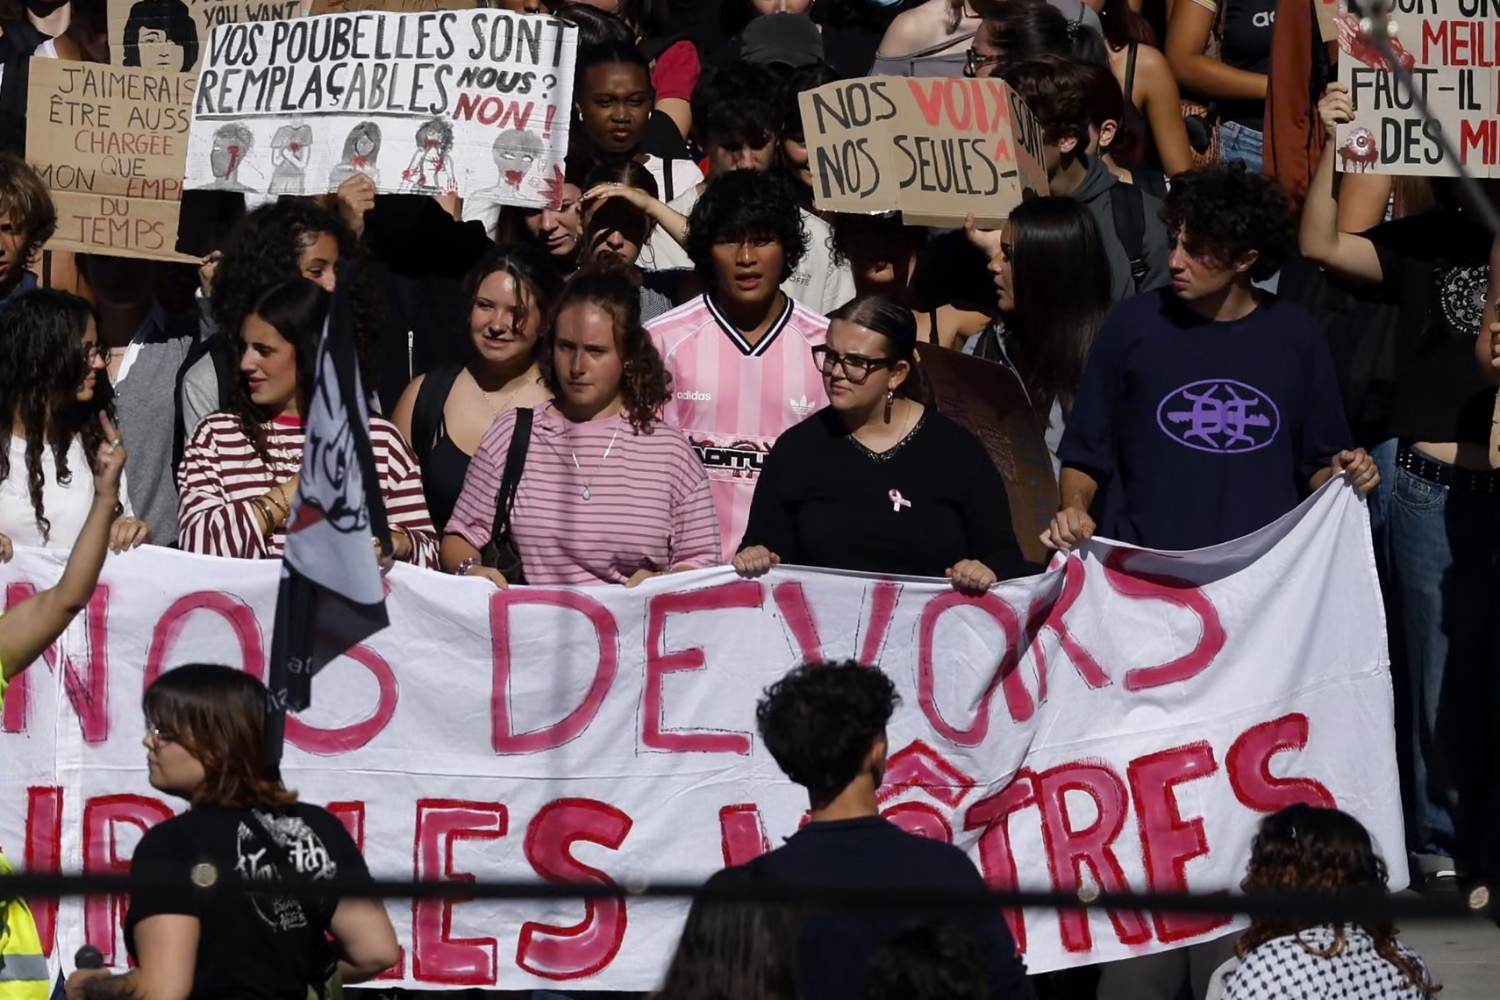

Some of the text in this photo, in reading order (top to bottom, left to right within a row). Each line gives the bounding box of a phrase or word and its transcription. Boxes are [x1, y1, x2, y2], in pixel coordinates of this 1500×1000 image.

[204, 0, 301, 28] YOU WANT
[209, 13, 578, 68] VOS POUBELLES SONT
[58, 66, 198, 106] J'AIMERAIS
[456, 65, 537, 95] NOUS
[49, 94, 111, 129] ÊTRE
[452, 98, 535, 132] NON
[814, 76, 1011, 136] NOS VOIX
[1380, 117, 1444, 165] DES
[101, 155, 147, 178] QUE
[819, 134, 1000, 199] NOS SEULES
[100, 197, 129, 217] DU
[72, 215, 164, 249] TEMPS
[676, 390, 712, 401] adidas
